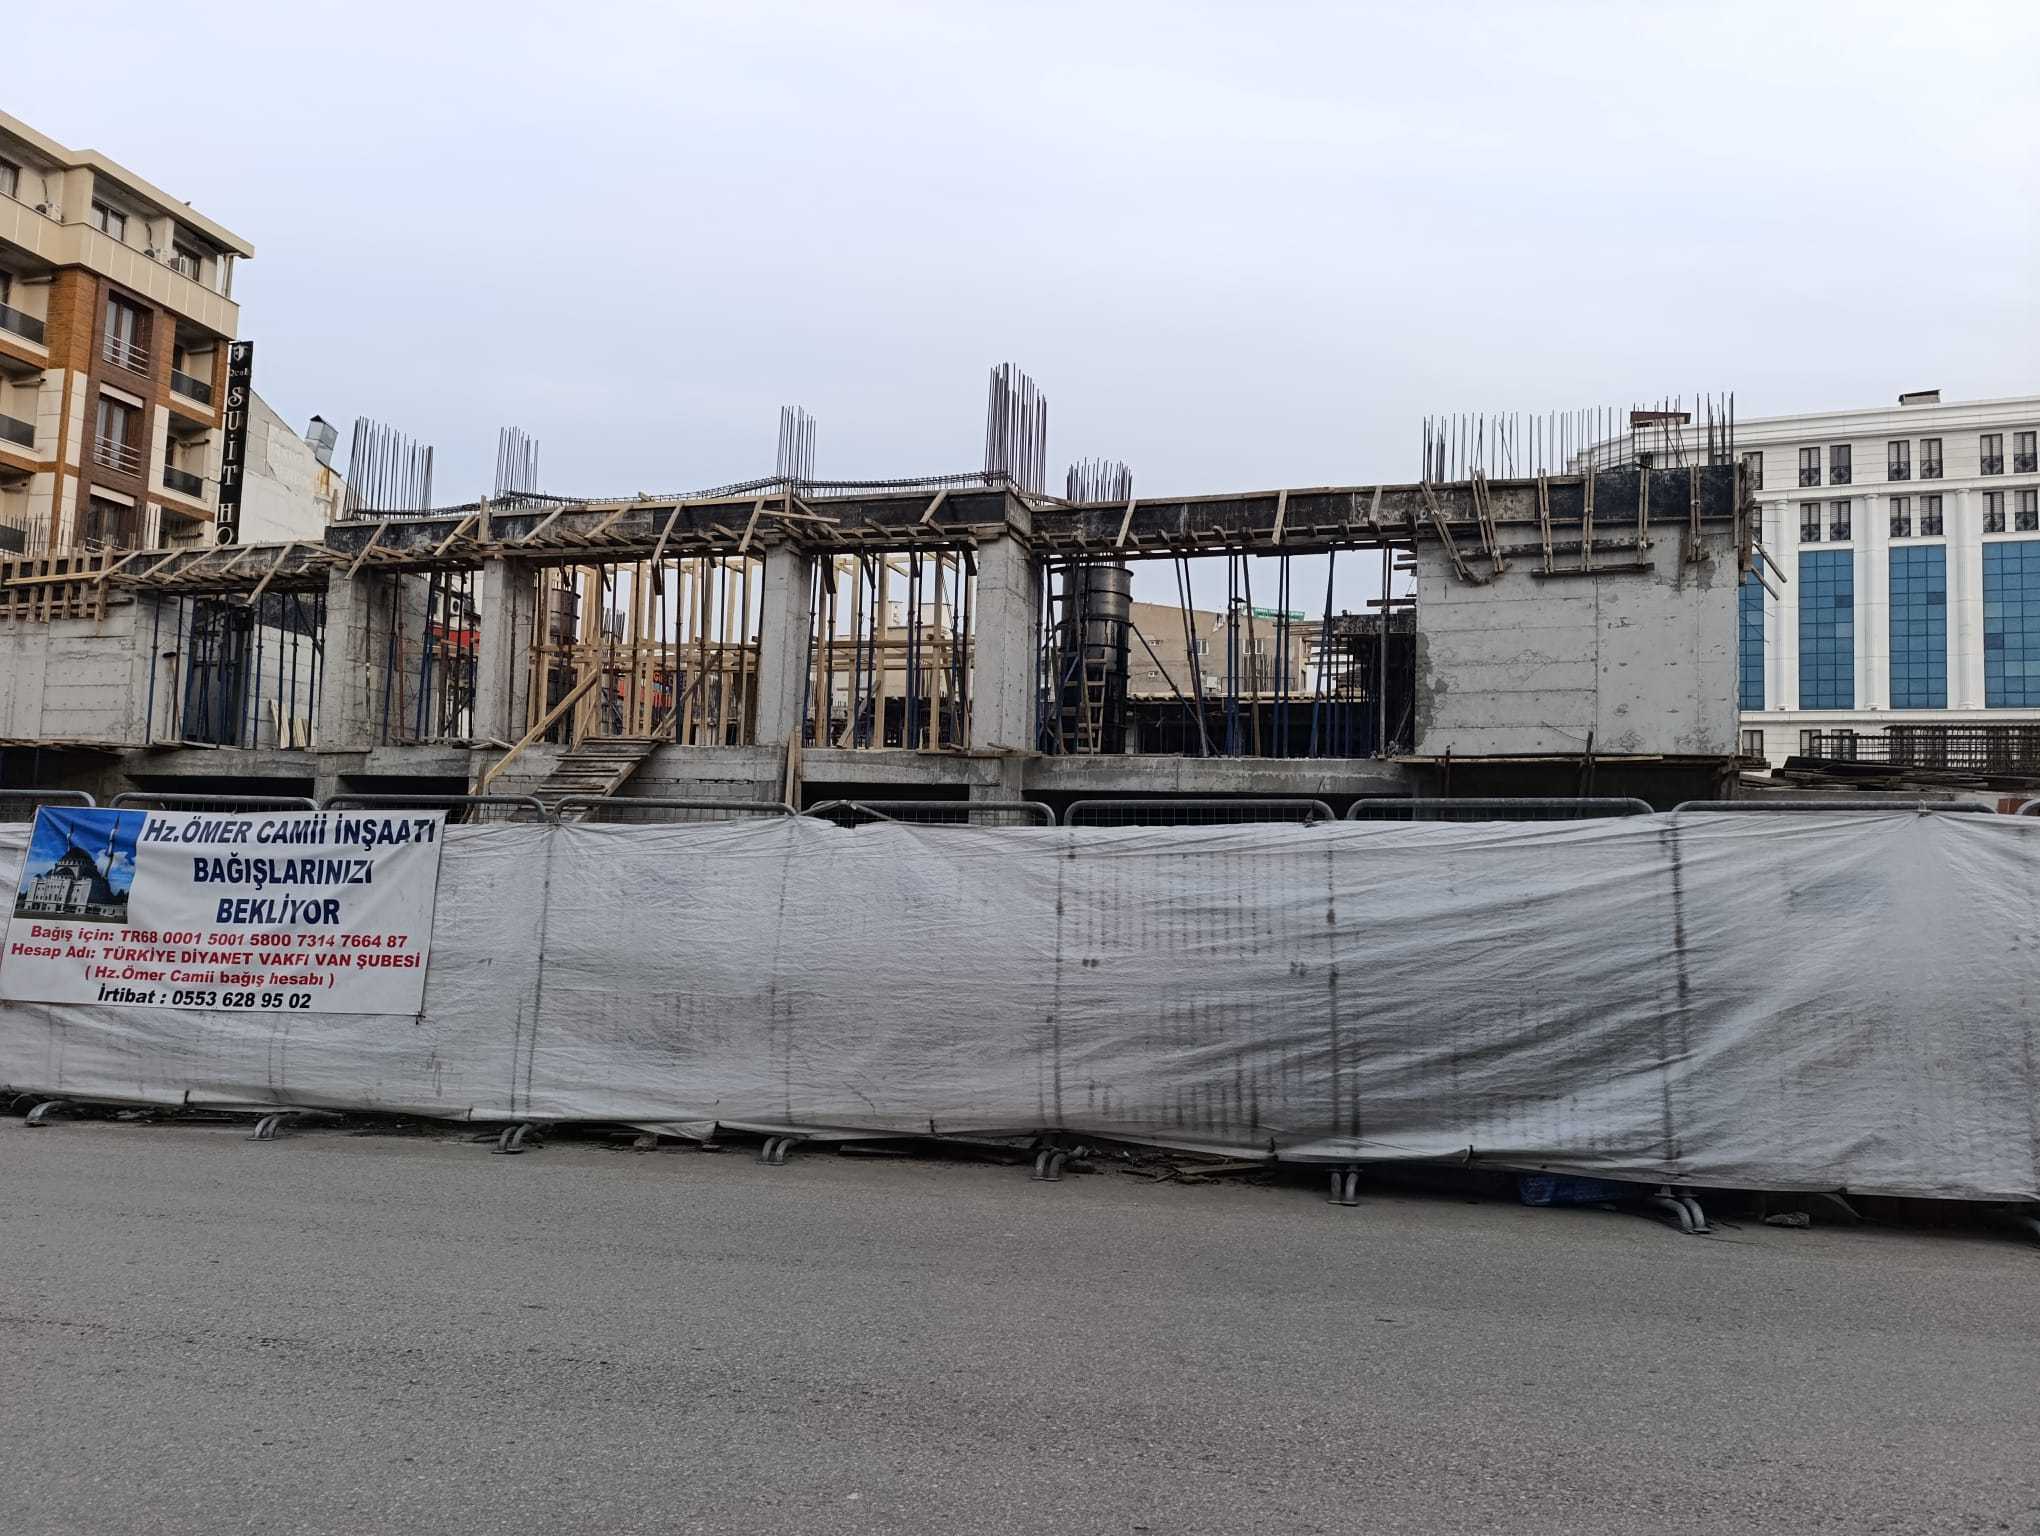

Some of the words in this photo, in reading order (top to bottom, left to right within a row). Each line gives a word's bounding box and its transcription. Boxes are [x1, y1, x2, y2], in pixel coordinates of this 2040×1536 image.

[143, 815, 252, 843] Hz.ÖMER
[334, 813, 436, 852] İNŞAATI
[193, 851, 374, 890] BAĞIŞLARINIZI
[215, 893, 340, 925] BEKLİYOR
[31, 925, 73, 943] Bağış
[78, 927, 114, 943] için:
[120, 930, 158, 944] TR68
[163, 932, 202, 945] 0001
[208, 932, 244, 946] 5001
[250, 934, 292, 947] 5800
[297, 934, 335, 947] 7314
[341, 935, 382, 948] 7664
[386, 935, 407, 948] 87
[11, 943, 61, 959] Hesap
[65, 947, 96, 959] Adı:
[102, 946, 176, 963] TÜRKİYE
[181, 949, 253, 965] DİYANET
[259, 952, 309, 967] VAKFI
[315, 953, 351, 967] VAN
[356, 951, 420, 970] ŞUBESİ
[95, 965, 166, 982] Hz.Ömer
[170, 969, 214, 983] Camii
[220, 971, 264, 988] bağış
[269, 972, 324, 986] hesabı
[97, 983, 156, 1004] İrtibat
[172, 990, 217, 1007] 0553
[222, 991, 256, 1008] 628
[261, 992, 284, 1008] 95
[288, 993, 312, 1009] 02
